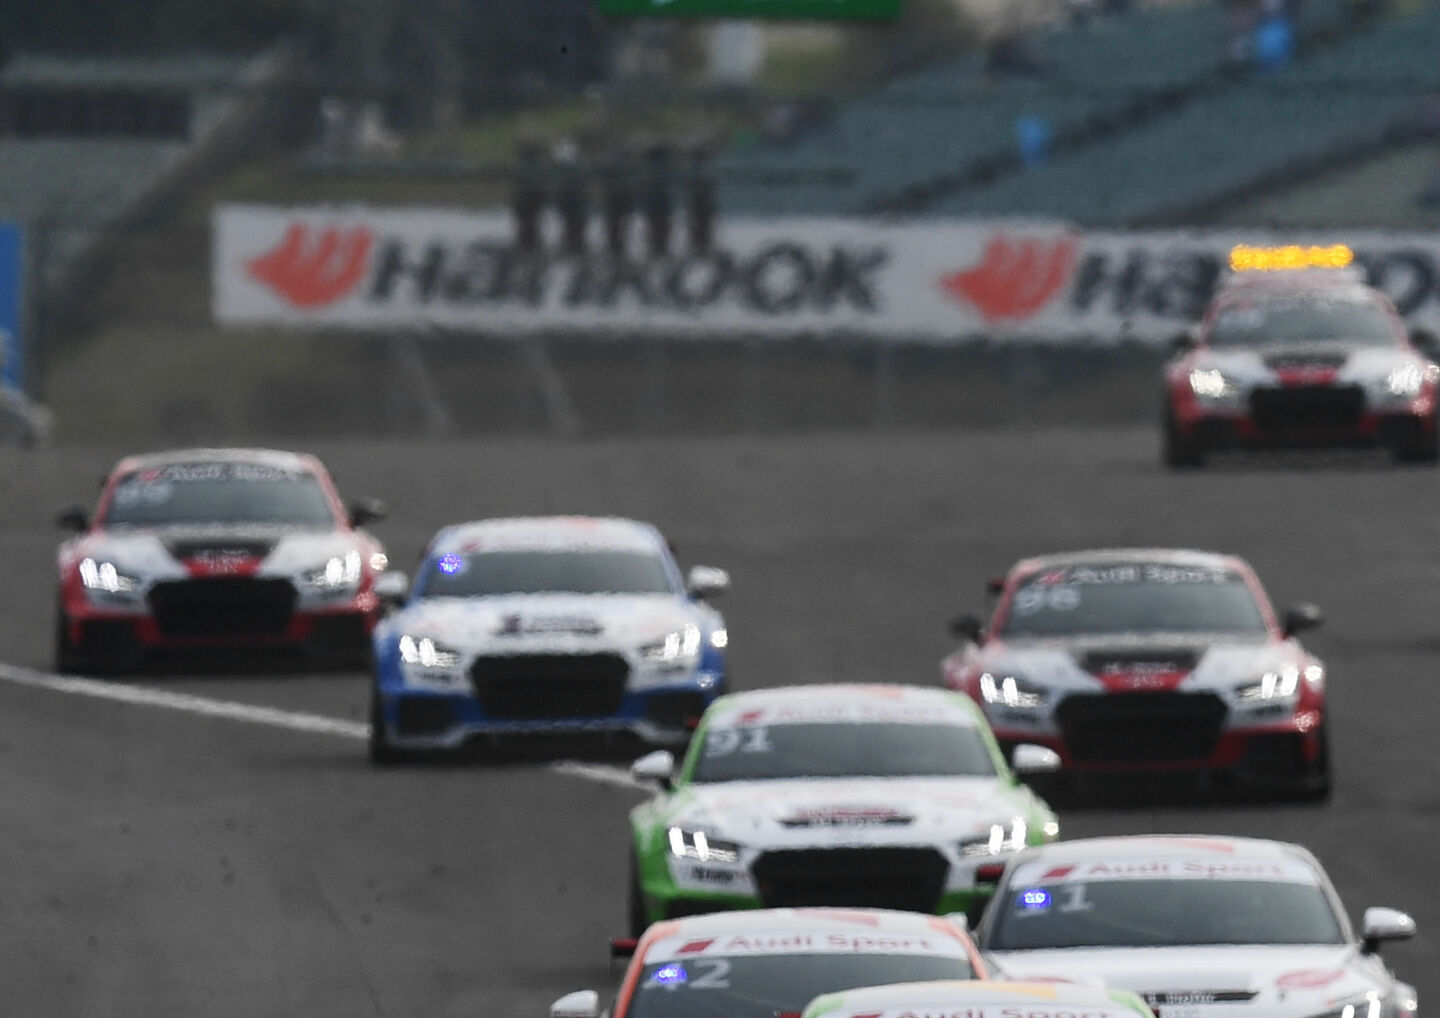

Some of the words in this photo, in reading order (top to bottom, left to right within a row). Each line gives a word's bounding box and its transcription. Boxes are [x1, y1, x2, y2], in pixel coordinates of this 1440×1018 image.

[1088, 862, 1170, 875] Audi
[1183, 861, 1284, 879] Sport
[726, 936, 812, 949] Audi
[827, 935, 931, 951] Sport
